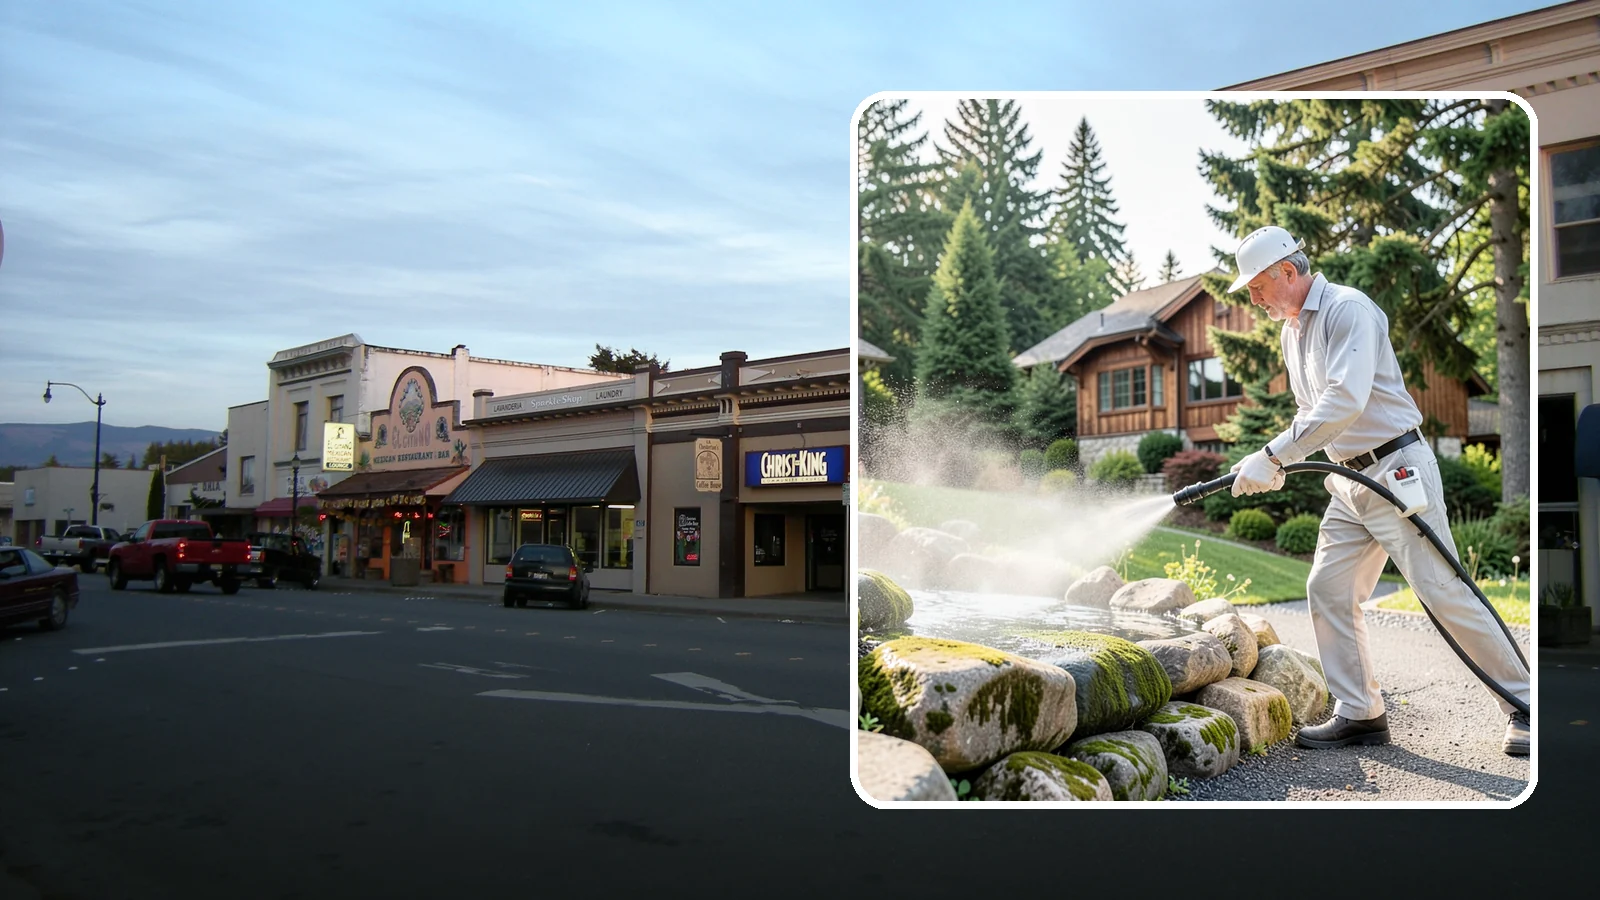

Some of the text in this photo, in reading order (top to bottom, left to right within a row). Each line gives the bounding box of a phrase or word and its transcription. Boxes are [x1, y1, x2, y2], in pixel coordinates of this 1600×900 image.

[595, 388, 623, 400] LAUNDRY
[493, 402, 522, 413] LAVANDERIA
[530, 394, 582, 409] Sparkle Shop
[373, 454, 396, 464] MEXICAN
[397, 451, 433, 463] RESTAURANT
[437, 450, 450, 459] BAR
[760, 452, 798, 478] CHRIST
[799, 450, 827, 476] KING
[696, 480, 709, 489] Coffee
